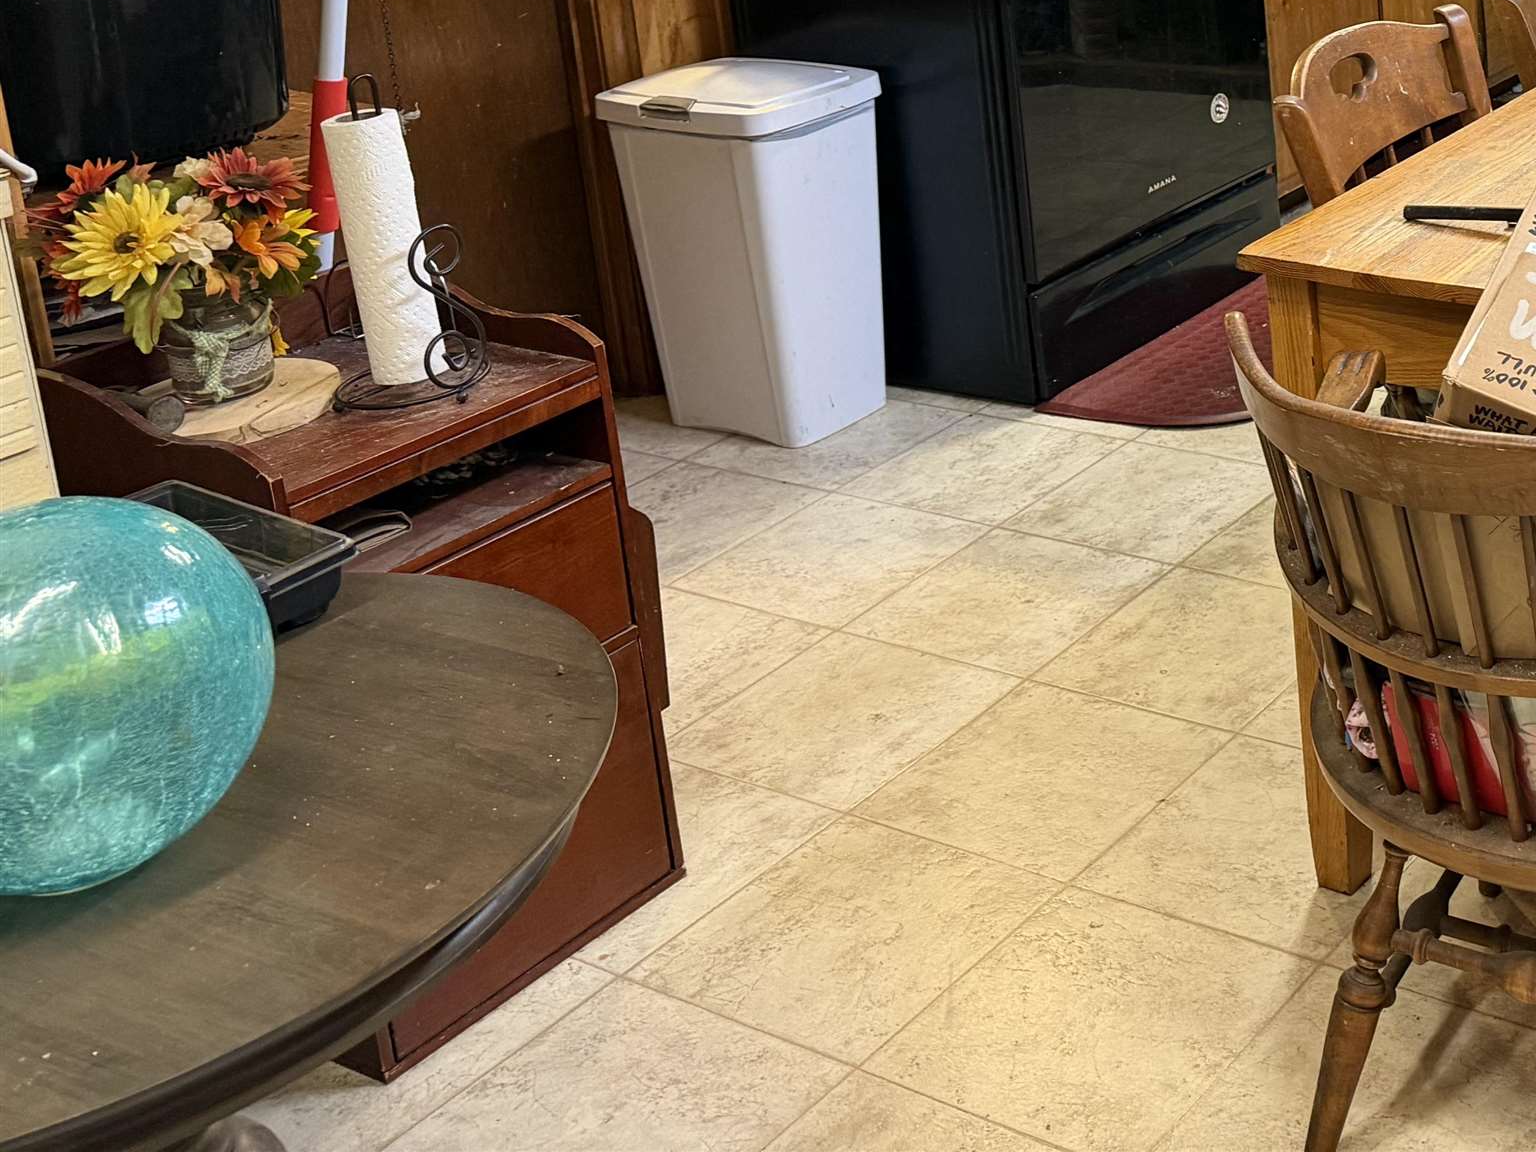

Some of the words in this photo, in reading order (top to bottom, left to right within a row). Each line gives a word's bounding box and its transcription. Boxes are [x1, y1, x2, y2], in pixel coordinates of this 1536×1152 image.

[1147, 174, 1177, 193] AMANA
[1481, 367, 1529, 392] 100%
[1474, 404, 1529, 430] WHAT
